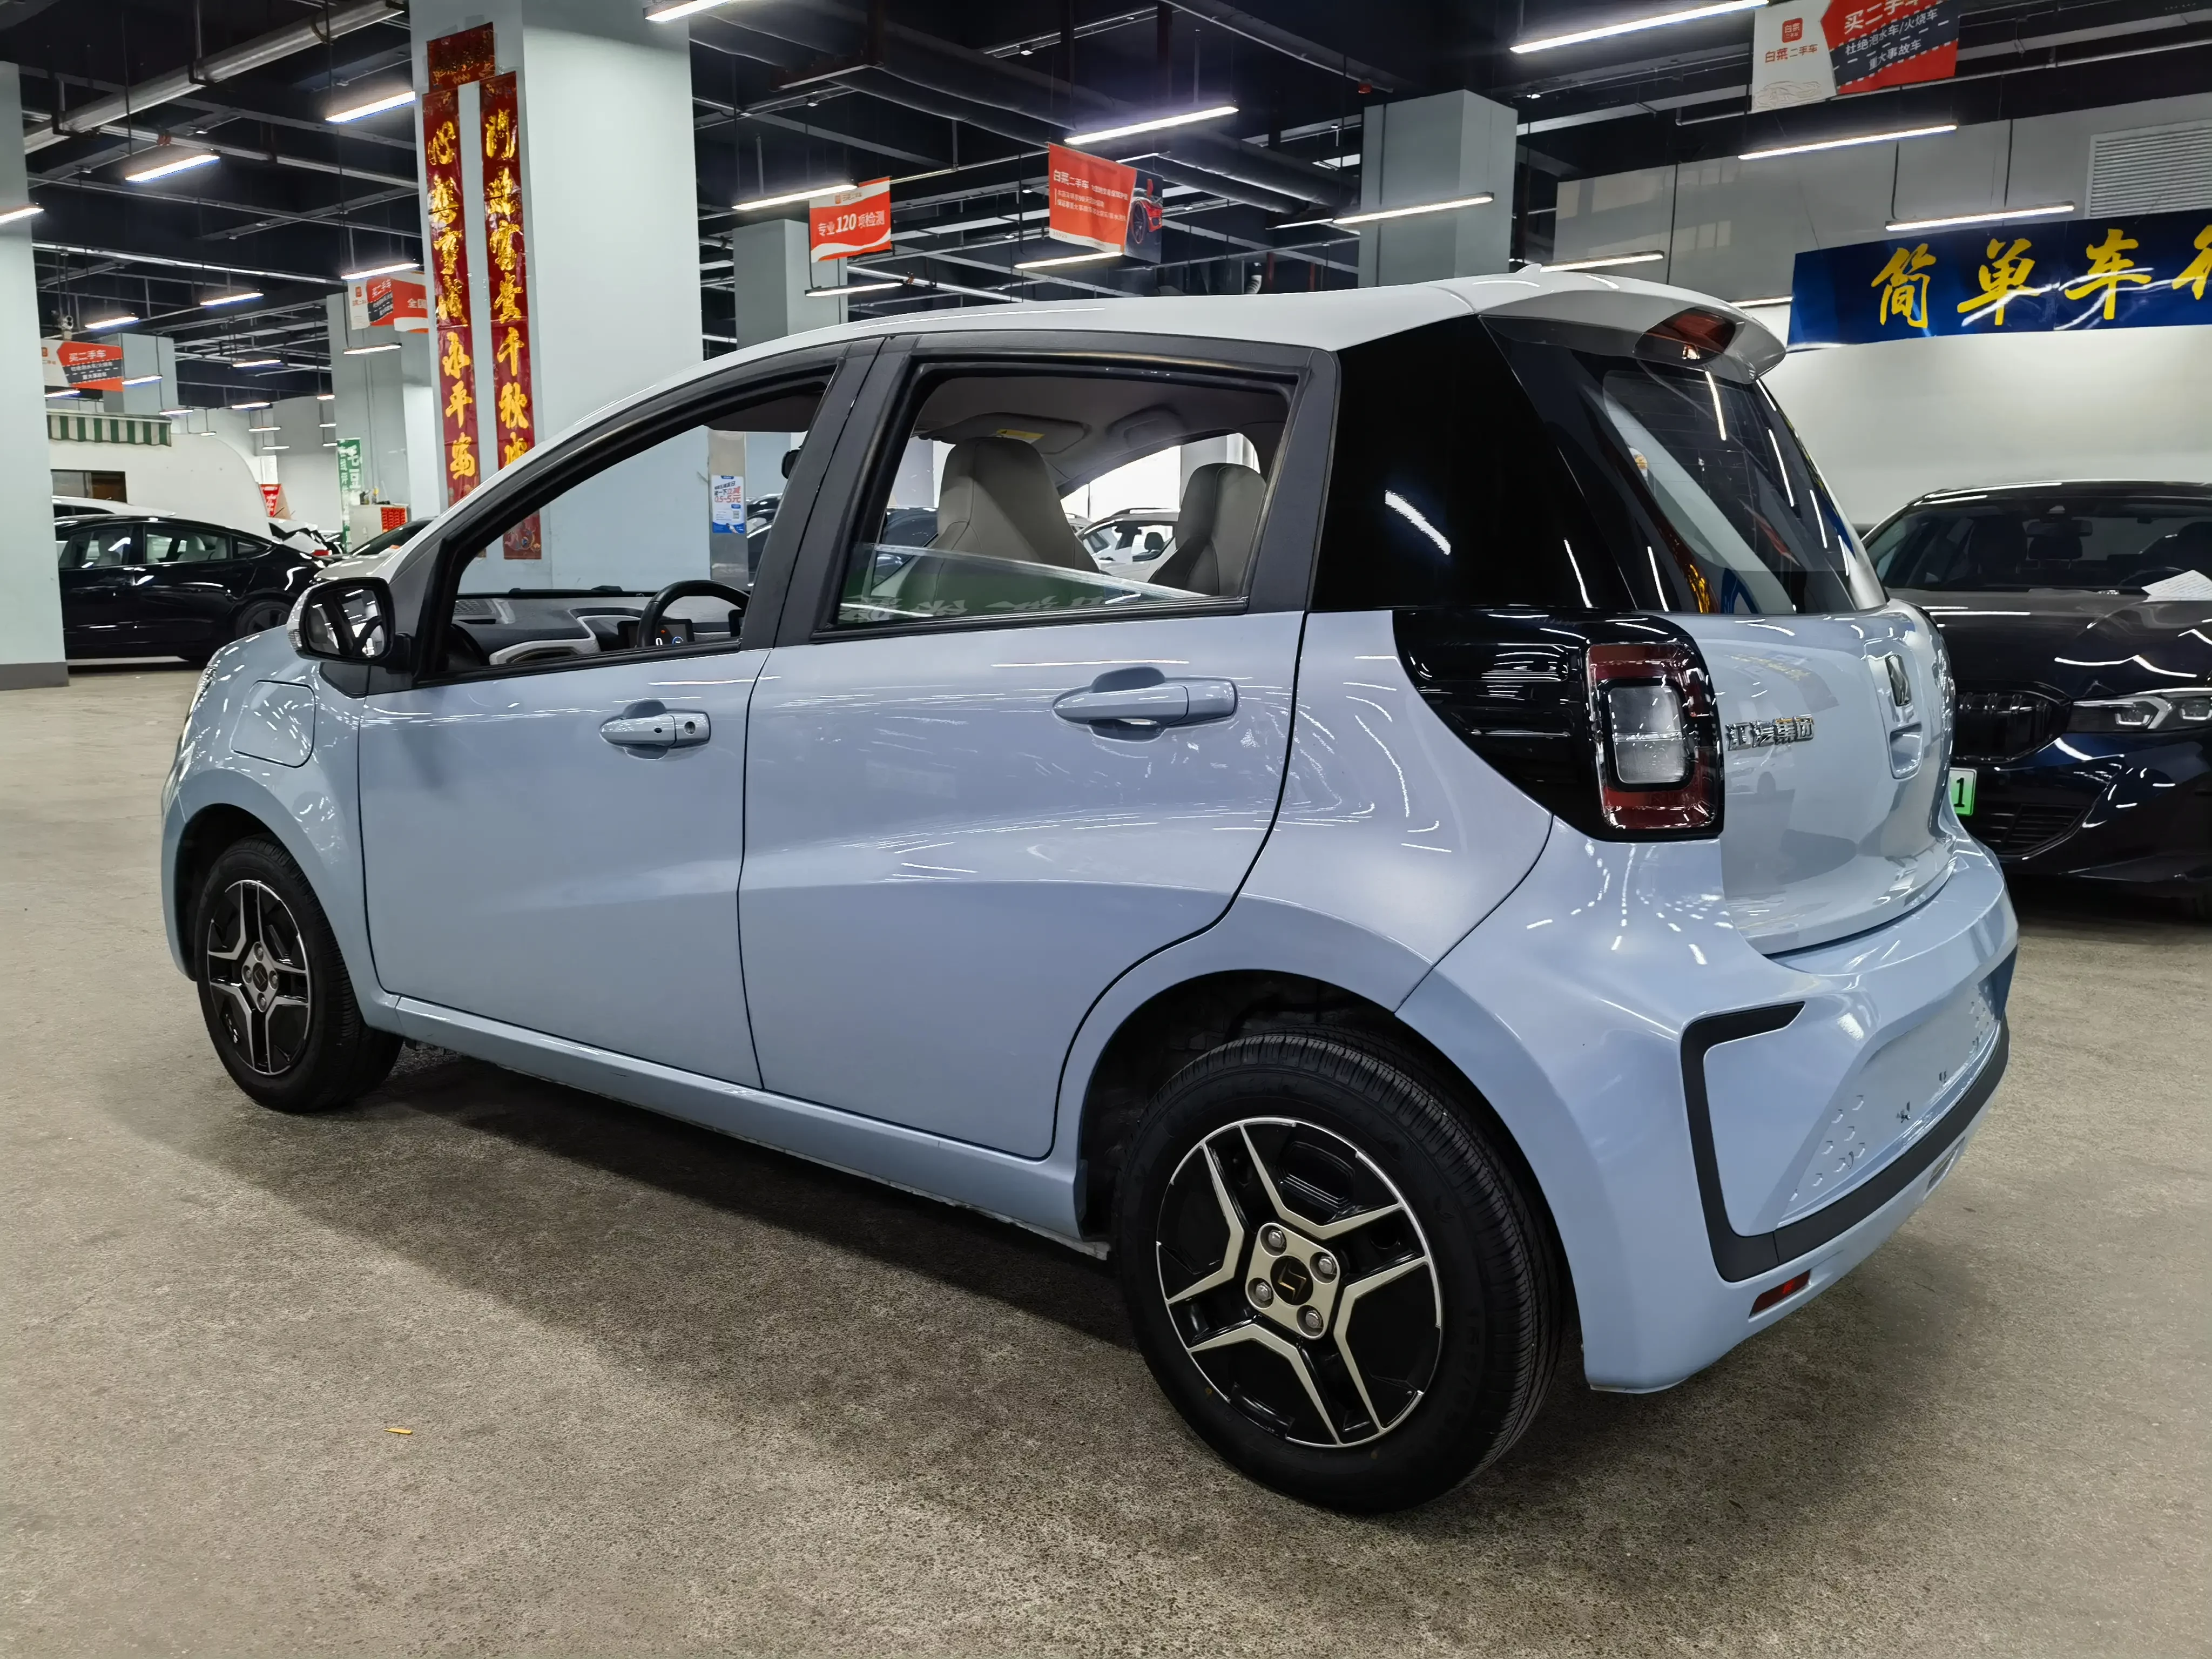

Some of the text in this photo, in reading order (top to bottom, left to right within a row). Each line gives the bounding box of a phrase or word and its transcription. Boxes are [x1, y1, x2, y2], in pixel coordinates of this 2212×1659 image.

[1845, 8, 1938, 56] 杜绝泡水车/火烧车
[1765, 44, 1818, 63] 白菜二手车
[1869, 38, 1922, 70] 重大事故车
[69, 349, 106, 362] 买二手车
